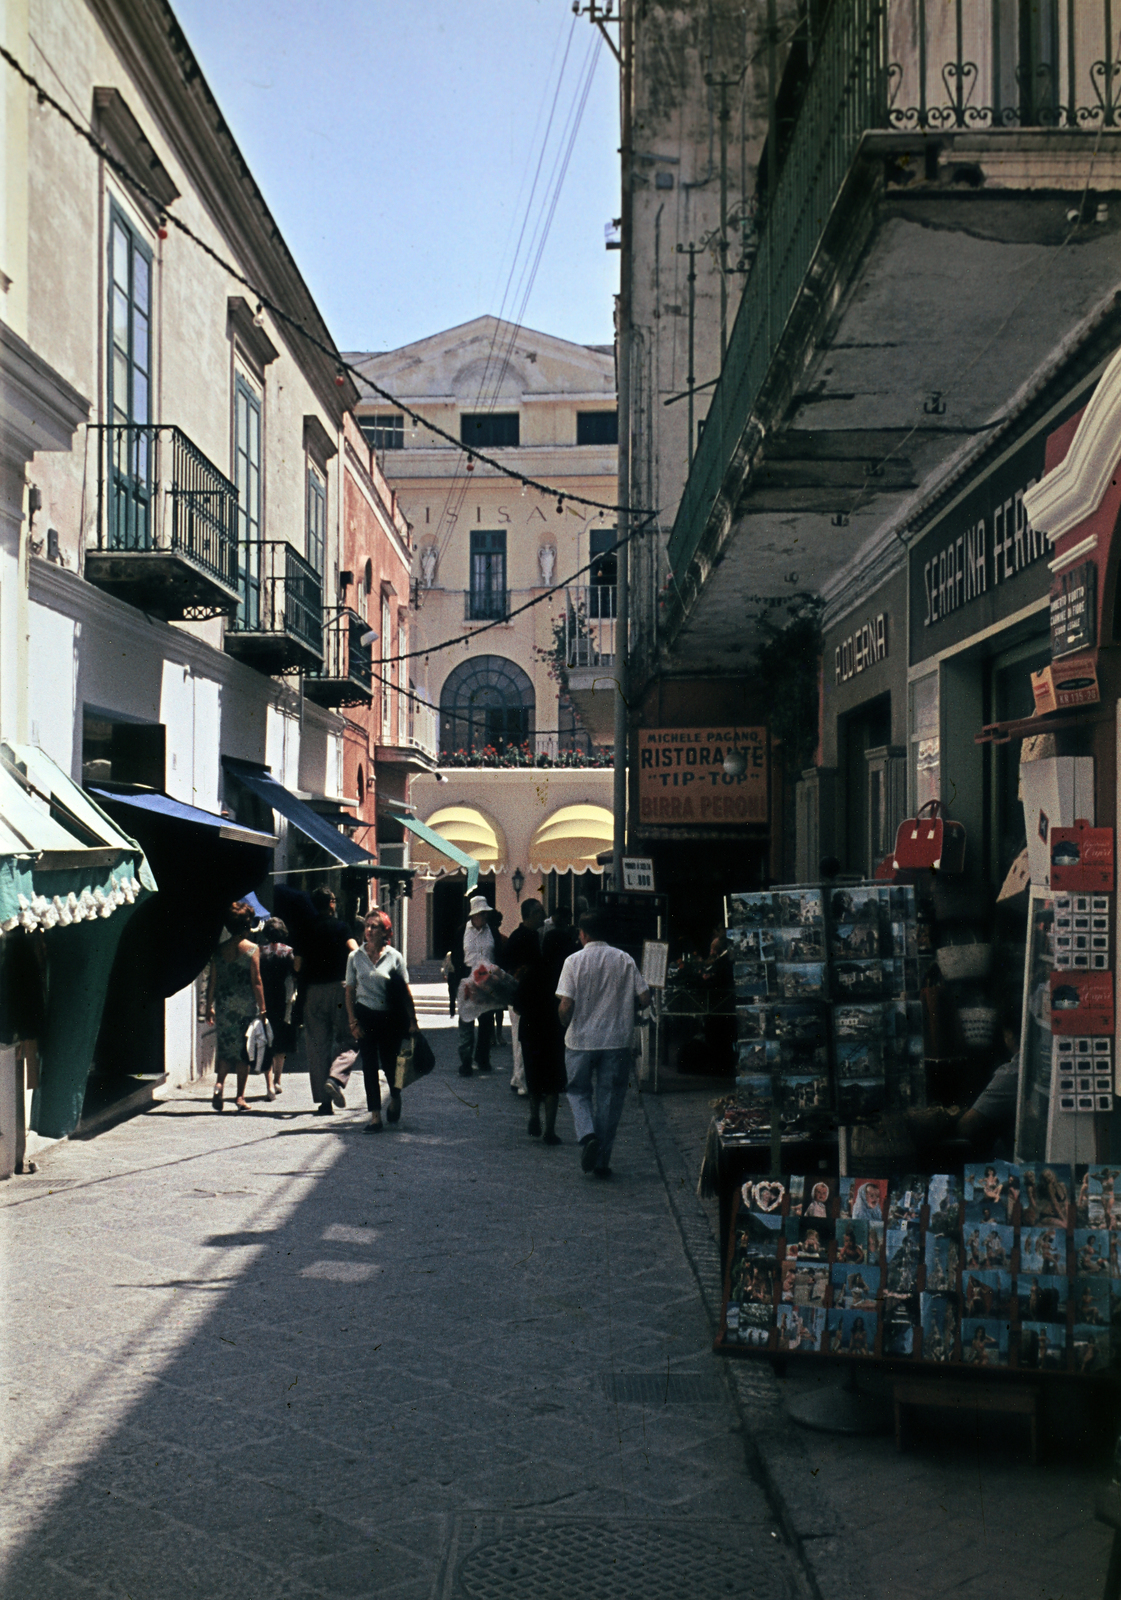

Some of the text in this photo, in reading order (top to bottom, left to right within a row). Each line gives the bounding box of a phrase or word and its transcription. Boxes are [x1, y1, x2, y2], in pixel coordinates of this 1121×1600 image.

[924, 518, 986, 627] SERAFINA
[647, 732, 701, 743] MICHELE
[641, 795, 765, 818] BIRRA PERONI
